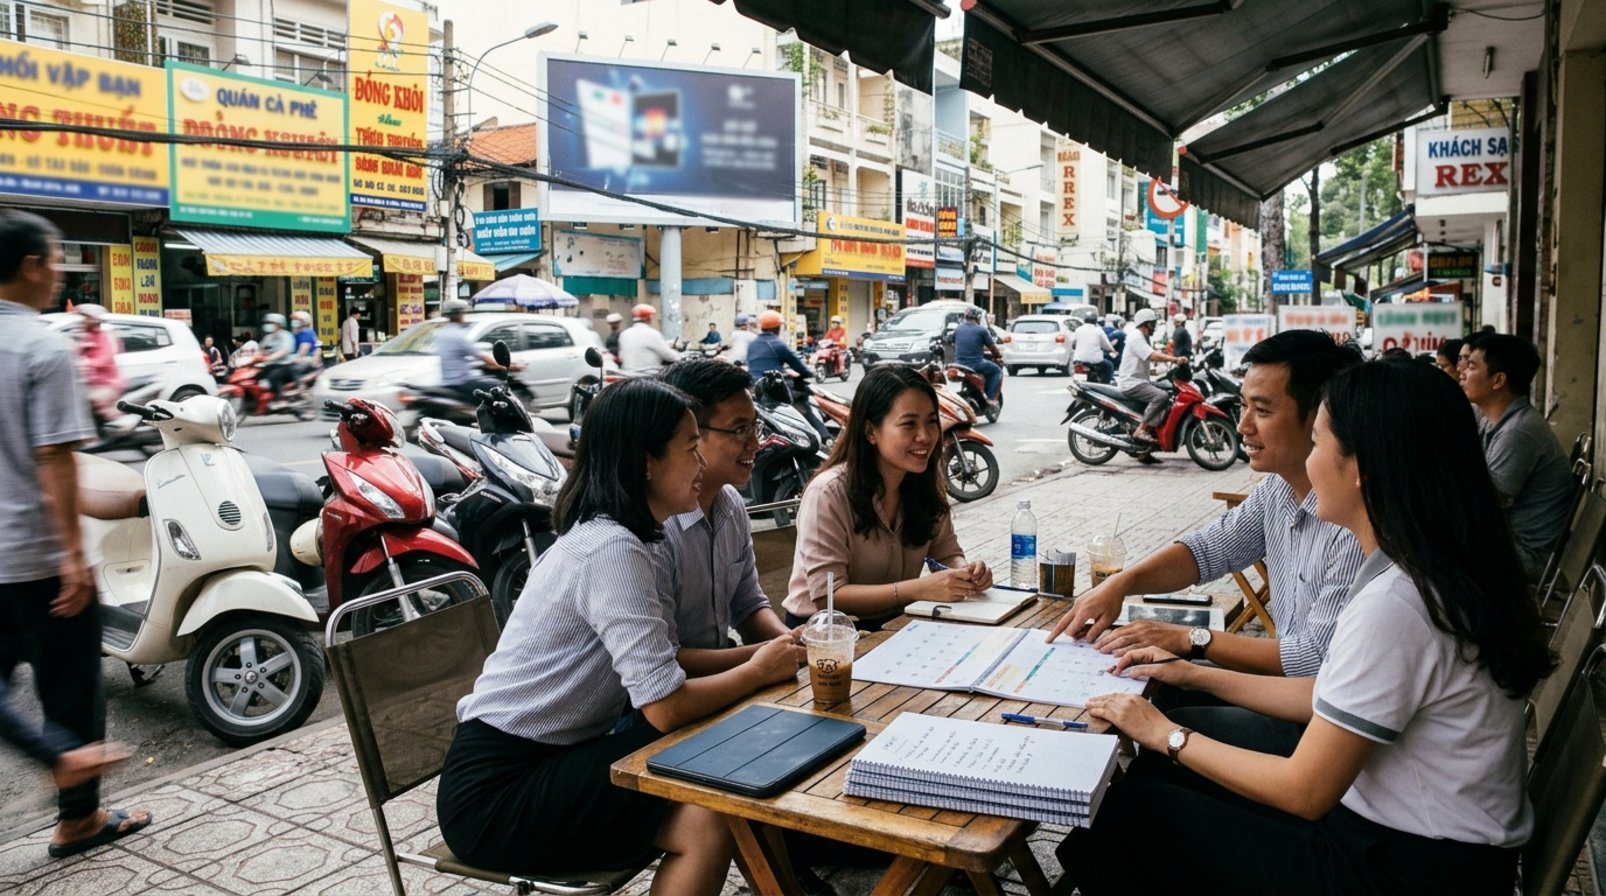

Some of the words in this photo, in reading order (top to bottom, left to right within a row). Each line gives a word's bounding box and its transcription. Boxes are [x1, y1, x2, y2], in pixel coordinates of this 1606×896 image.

[217, 88, 260, 110] QUÁN
[265, 93, 285, 115] CÀ
[1428, 135, 1482, 158] KHÁCH
[1434, 161, 1509, 188] REX
